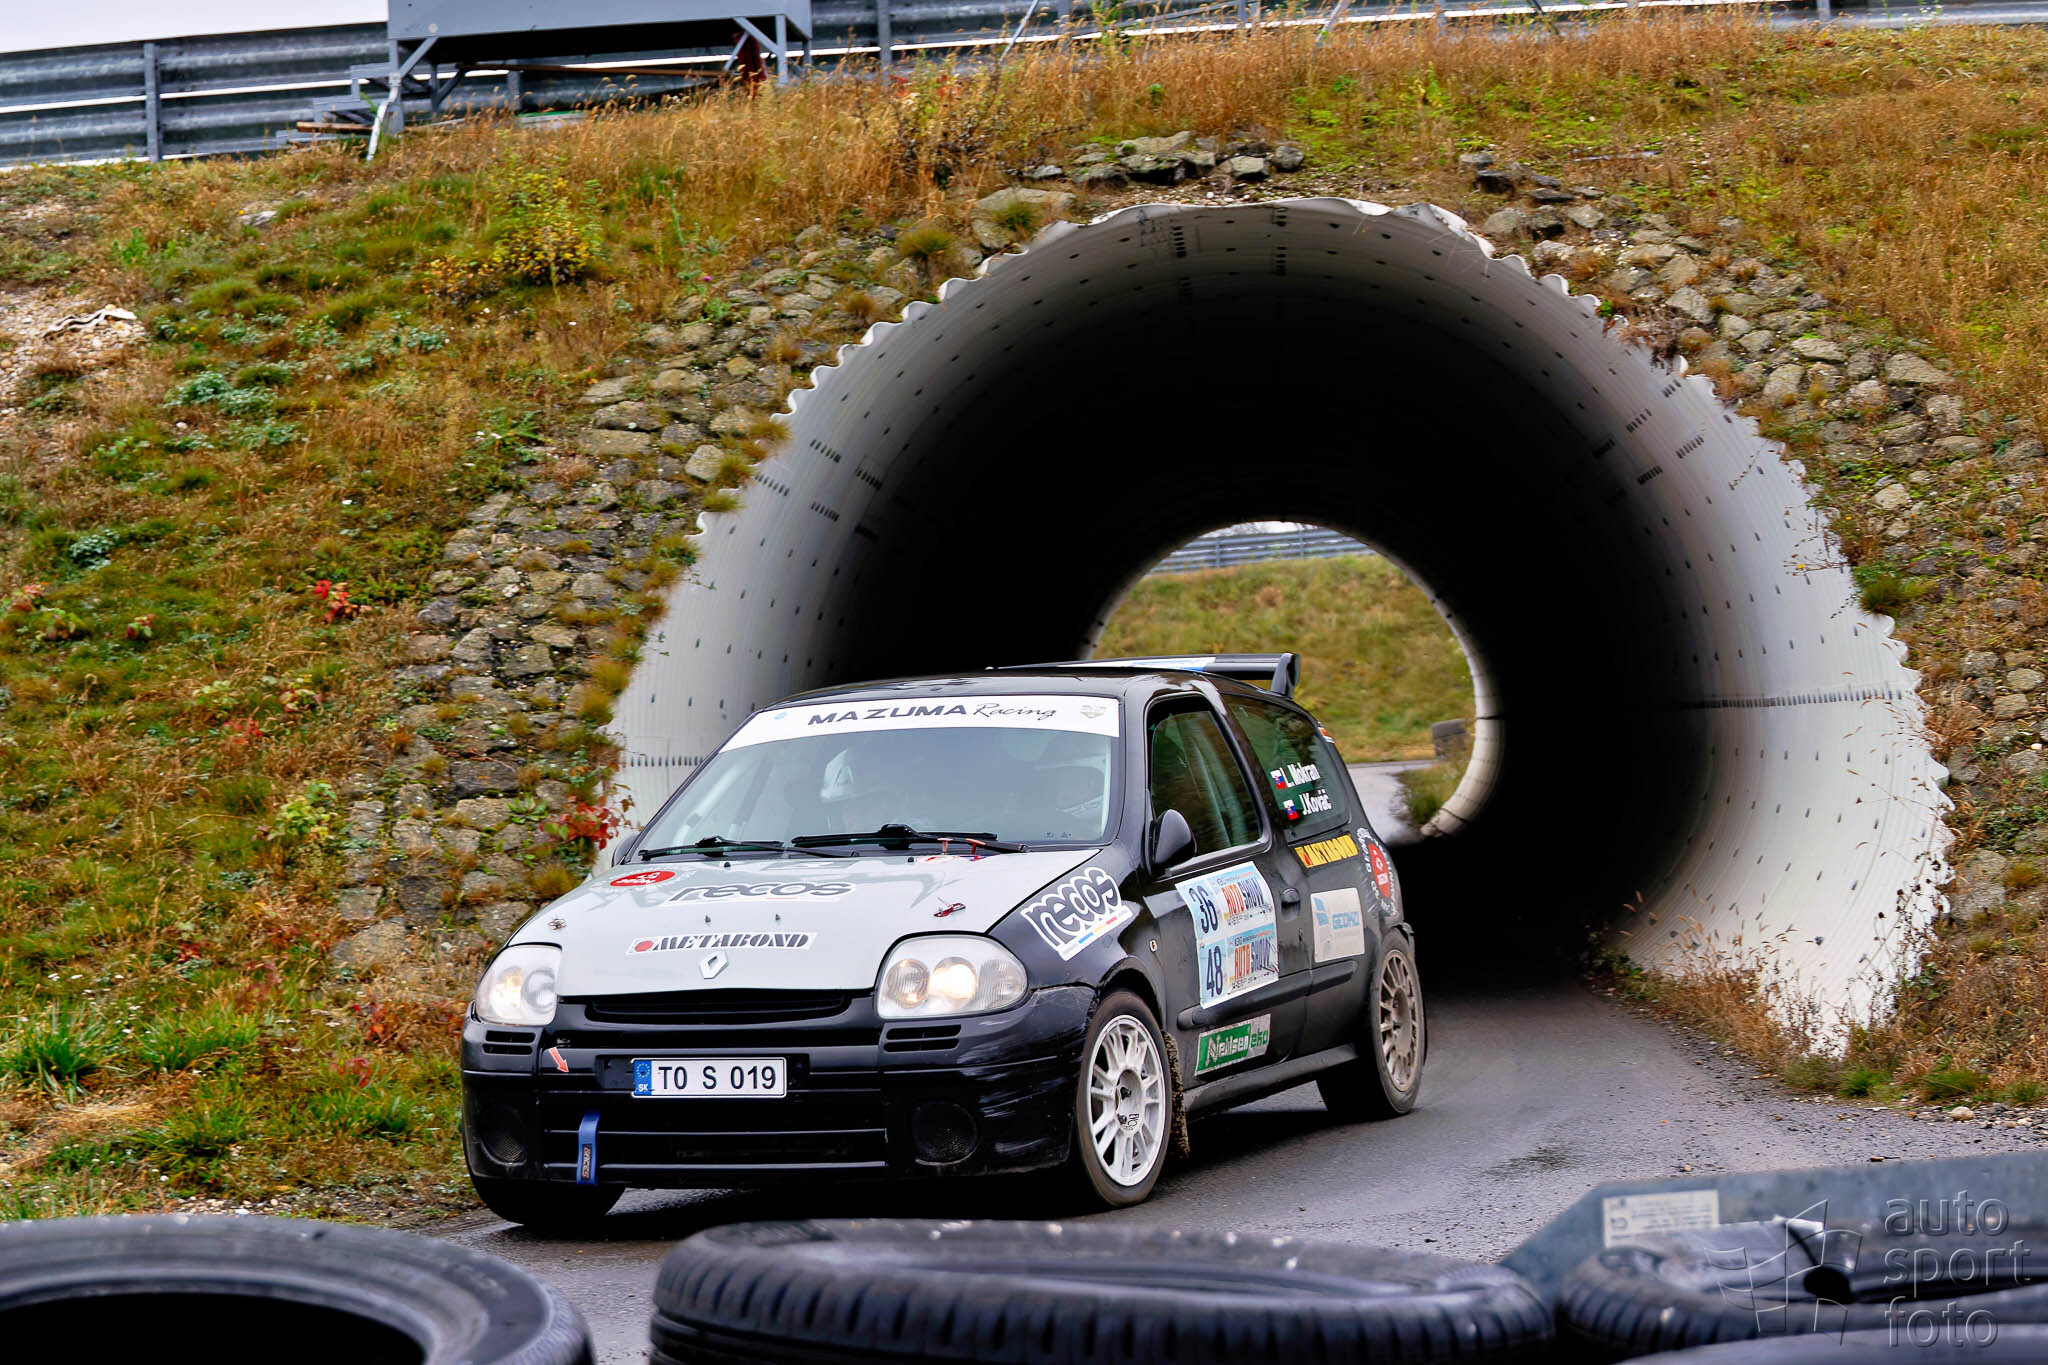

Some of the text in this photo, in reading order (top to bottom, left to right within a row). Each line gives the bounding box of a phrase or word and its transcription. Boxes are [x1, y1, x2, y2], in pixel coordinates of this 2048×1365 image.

[807, 703, 1057, 726] MAZUMA Racing
[668, 882, 855, 902] recos
[1023, 867, 1120, 948] recos
[1188, 885, 1219, 934] 36
[652, 933, 810, 951] METABOND
[1206, 945, 1223, 998] 48
[1234, 944, 1251, 980] AUTO
[638, 1083, 649, 1092] SK
[702, 1065, 718, 1090] S
[730, 1065, 776, 1090] 019
